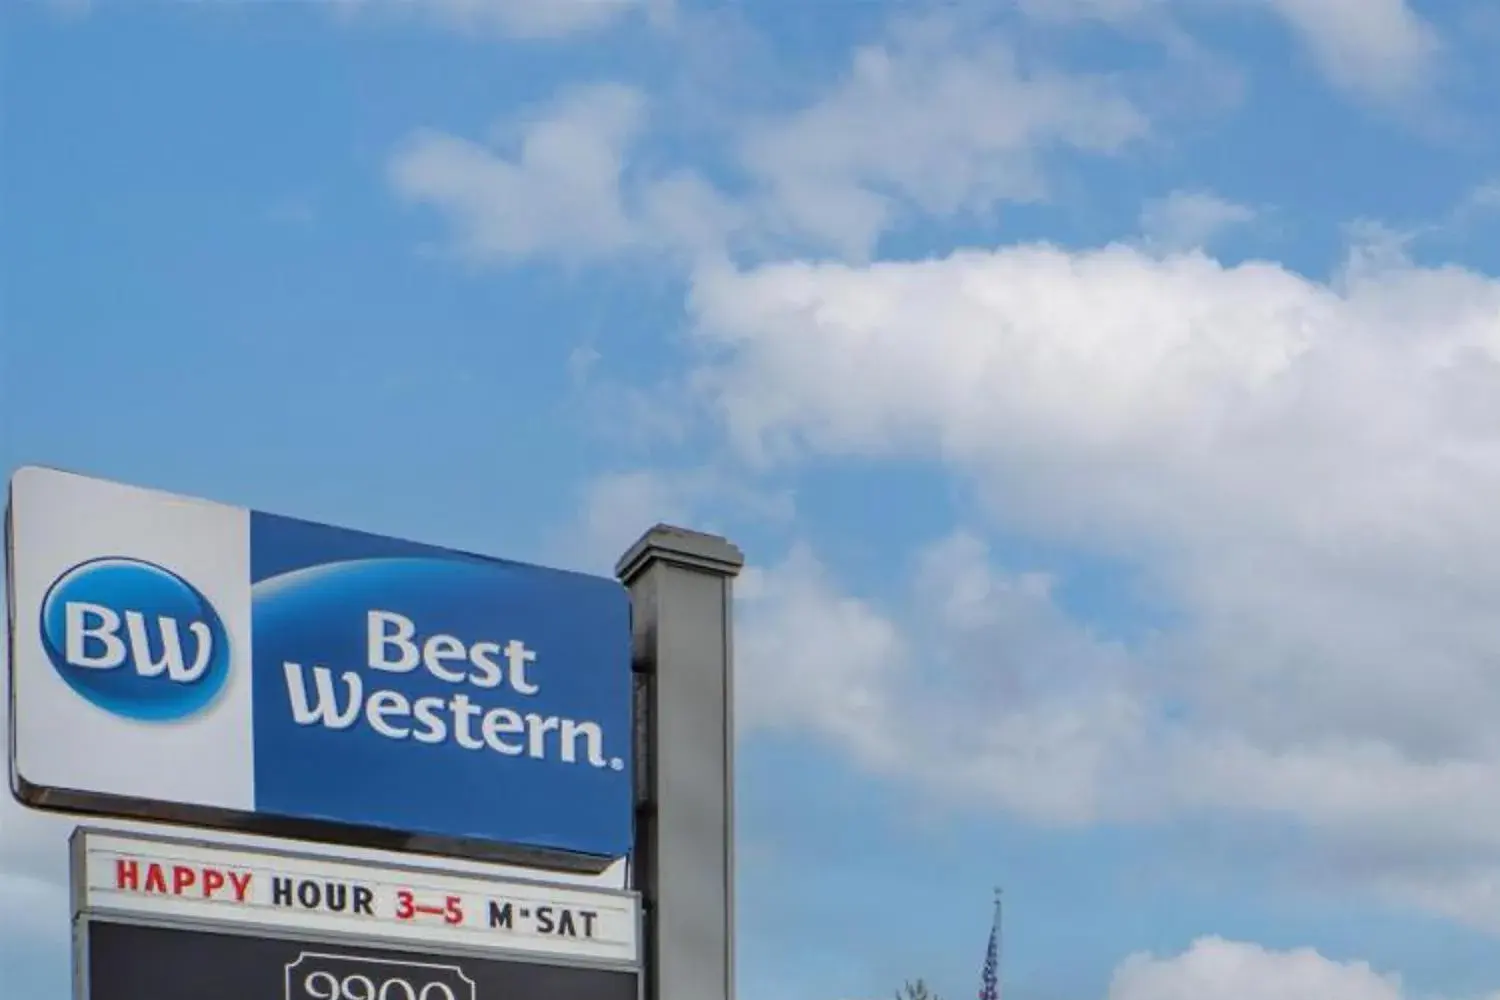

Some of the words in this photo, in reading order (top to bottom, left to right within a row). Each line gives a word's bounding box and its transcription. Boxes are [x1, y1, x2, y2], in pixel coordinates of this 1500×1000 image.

[65, 601, 213, 683] BW
[367, 610, 539, 695] Best
[283, 661, 607, 768] Western
[116, 858, 253, 902] HAPPY
[272, 876, 374, 915] HOUR
